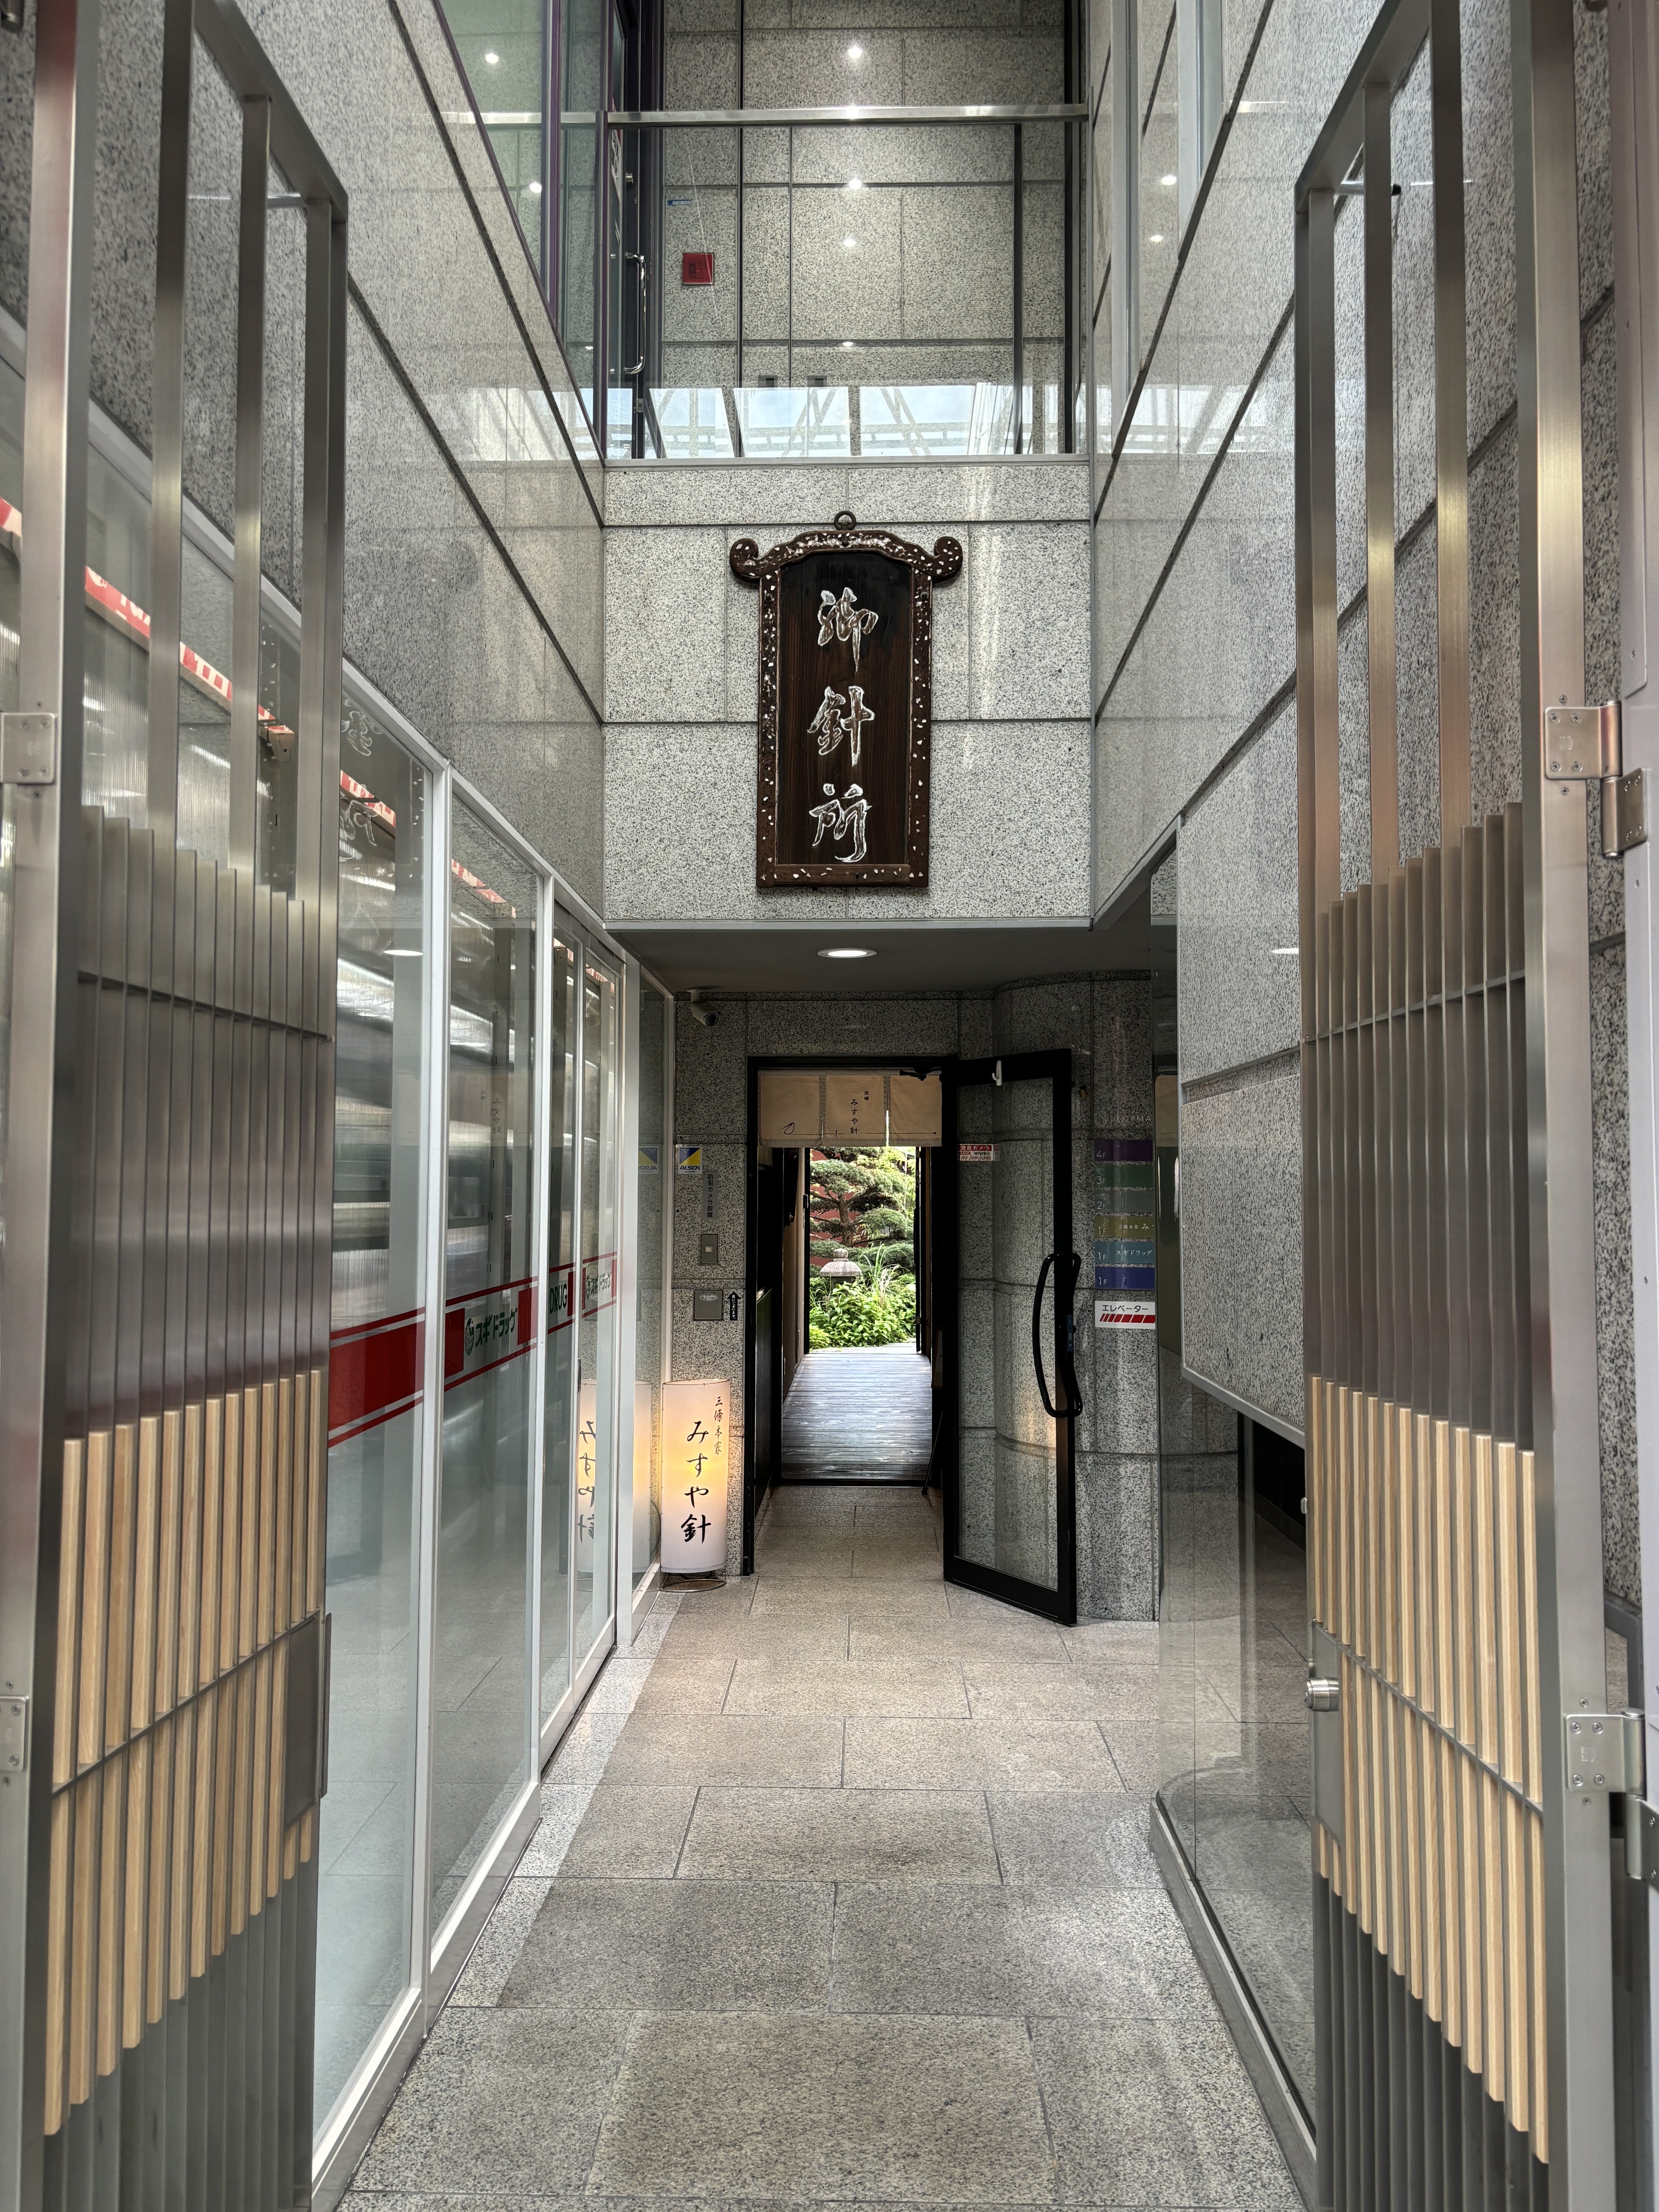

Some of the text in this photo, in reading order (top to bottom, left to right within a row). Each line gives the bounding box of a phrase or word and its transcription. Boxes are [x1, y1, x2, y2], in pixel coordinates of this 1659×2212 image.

[850, 1099, 859, 1134] みすや針
[1096, 1150, 1106, 1158] 4F
[1096, 1176, 1106, 1184] 3F
[1097, 1201, 1106, 1209] 2F
[1098, 1226, 1107, 1235] 1F
[1098, 1252, 1107, 1261] 1F
[1098, 1277, 1108, 1285] 1F
[549, 1283, 567, 1314] DRUG
[475, 1307, 518, 1348] スギドラッグ
[680, 1420, 712, 1544] みすや針
